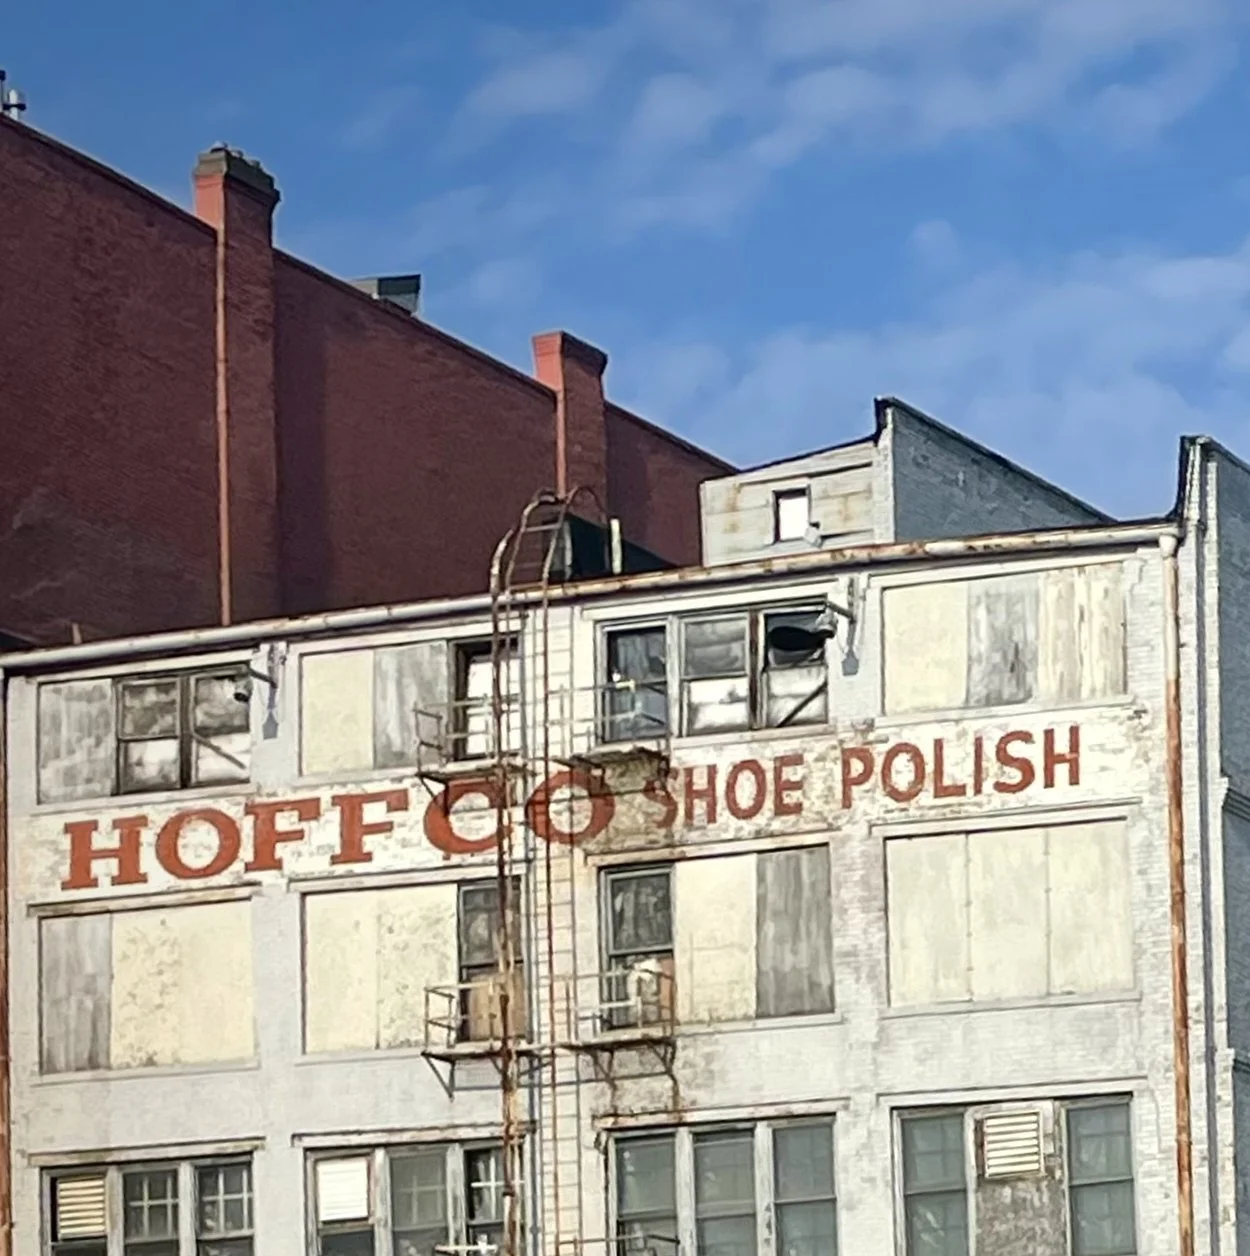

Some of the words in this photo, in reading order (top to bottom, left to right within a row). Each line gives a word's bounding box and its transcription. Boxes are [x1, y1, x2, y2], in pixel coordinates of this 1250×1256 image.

[61, 768, 615, 890] HOFFCO
[642, 754, 803, 830] SHOE
[841, 725, 1080, 809] POLISH
